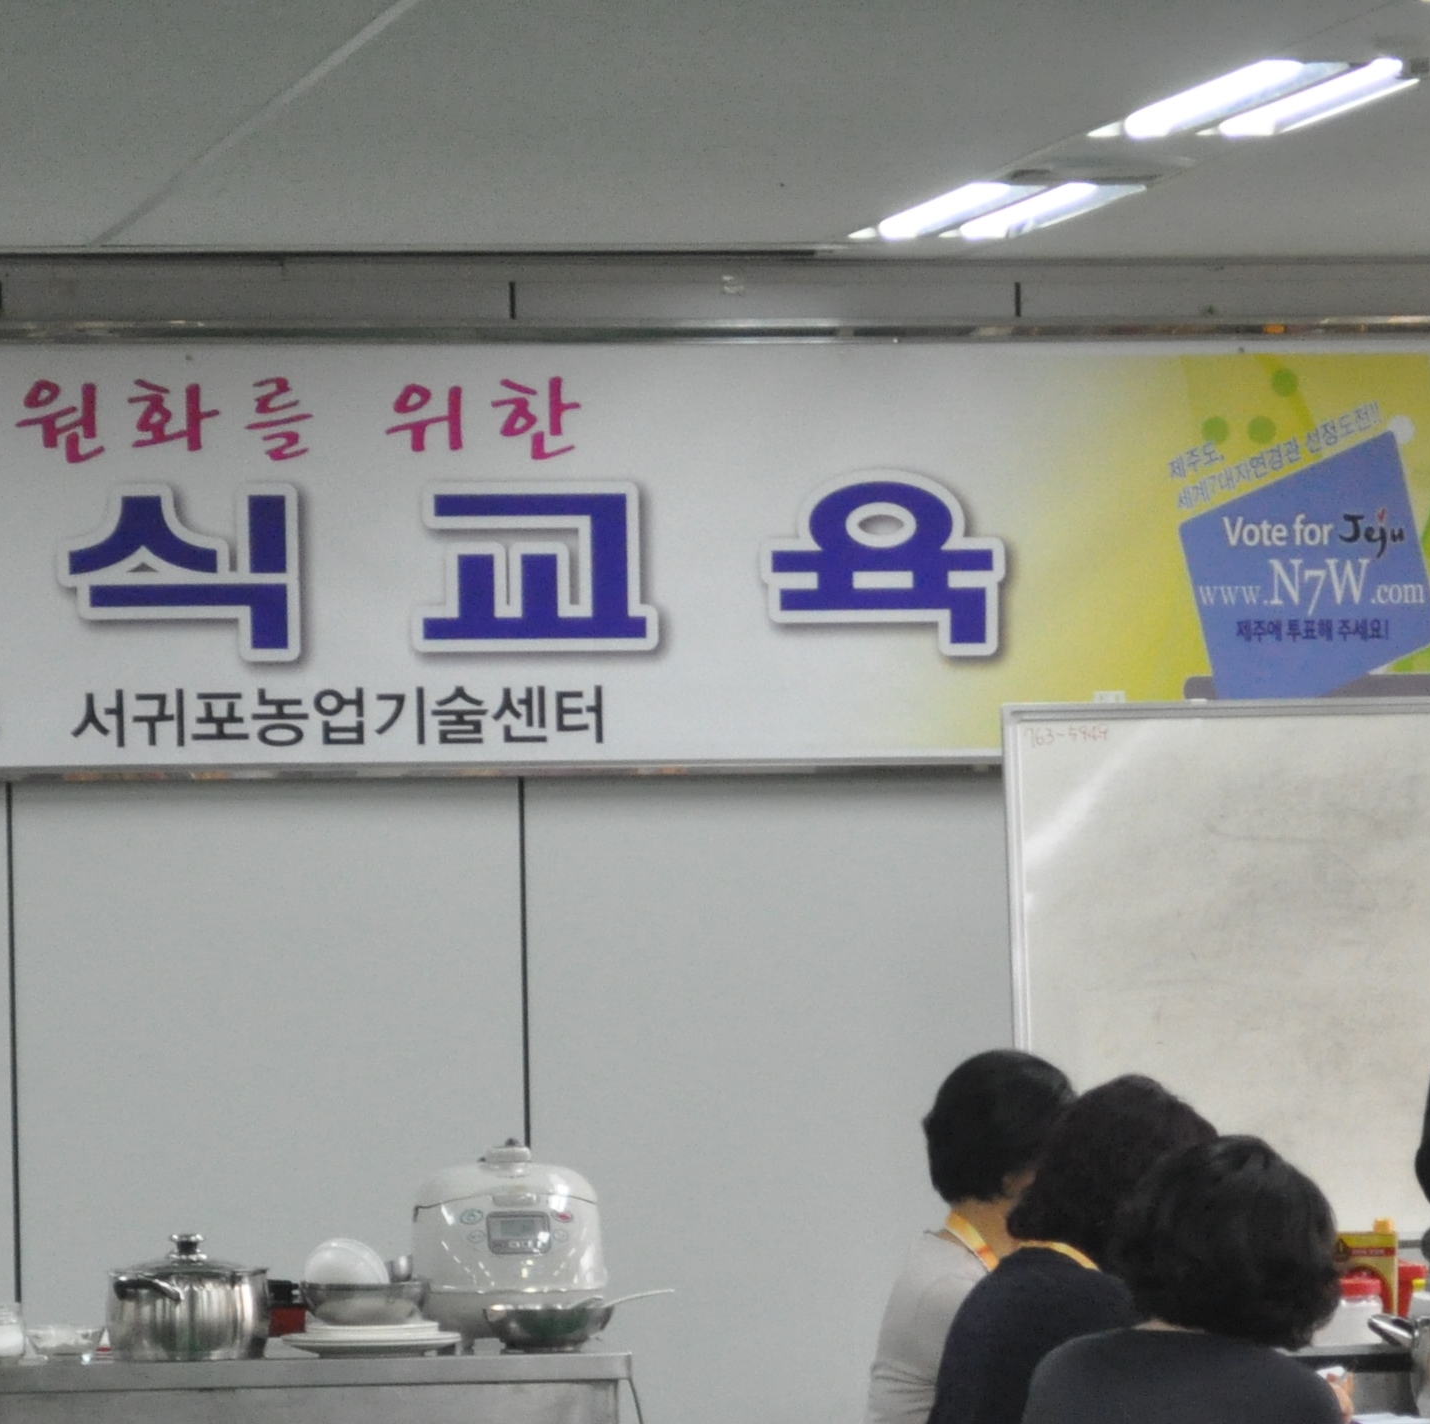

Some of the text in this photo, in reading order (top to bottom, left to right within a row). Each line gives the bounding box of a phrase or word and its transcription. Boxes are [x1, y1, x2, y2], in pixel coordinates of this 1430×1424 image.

[386, 376, 581, 461] 위한
[1222, 508, 1405, 558] Vote for Jeju
[1199, 558, 1425, 617] www.N7W.com
[1236, 618, 1389, 642] 제주에 투표해 주세요!
[70, 685, 604, 748] 서귀포농업기술센터
